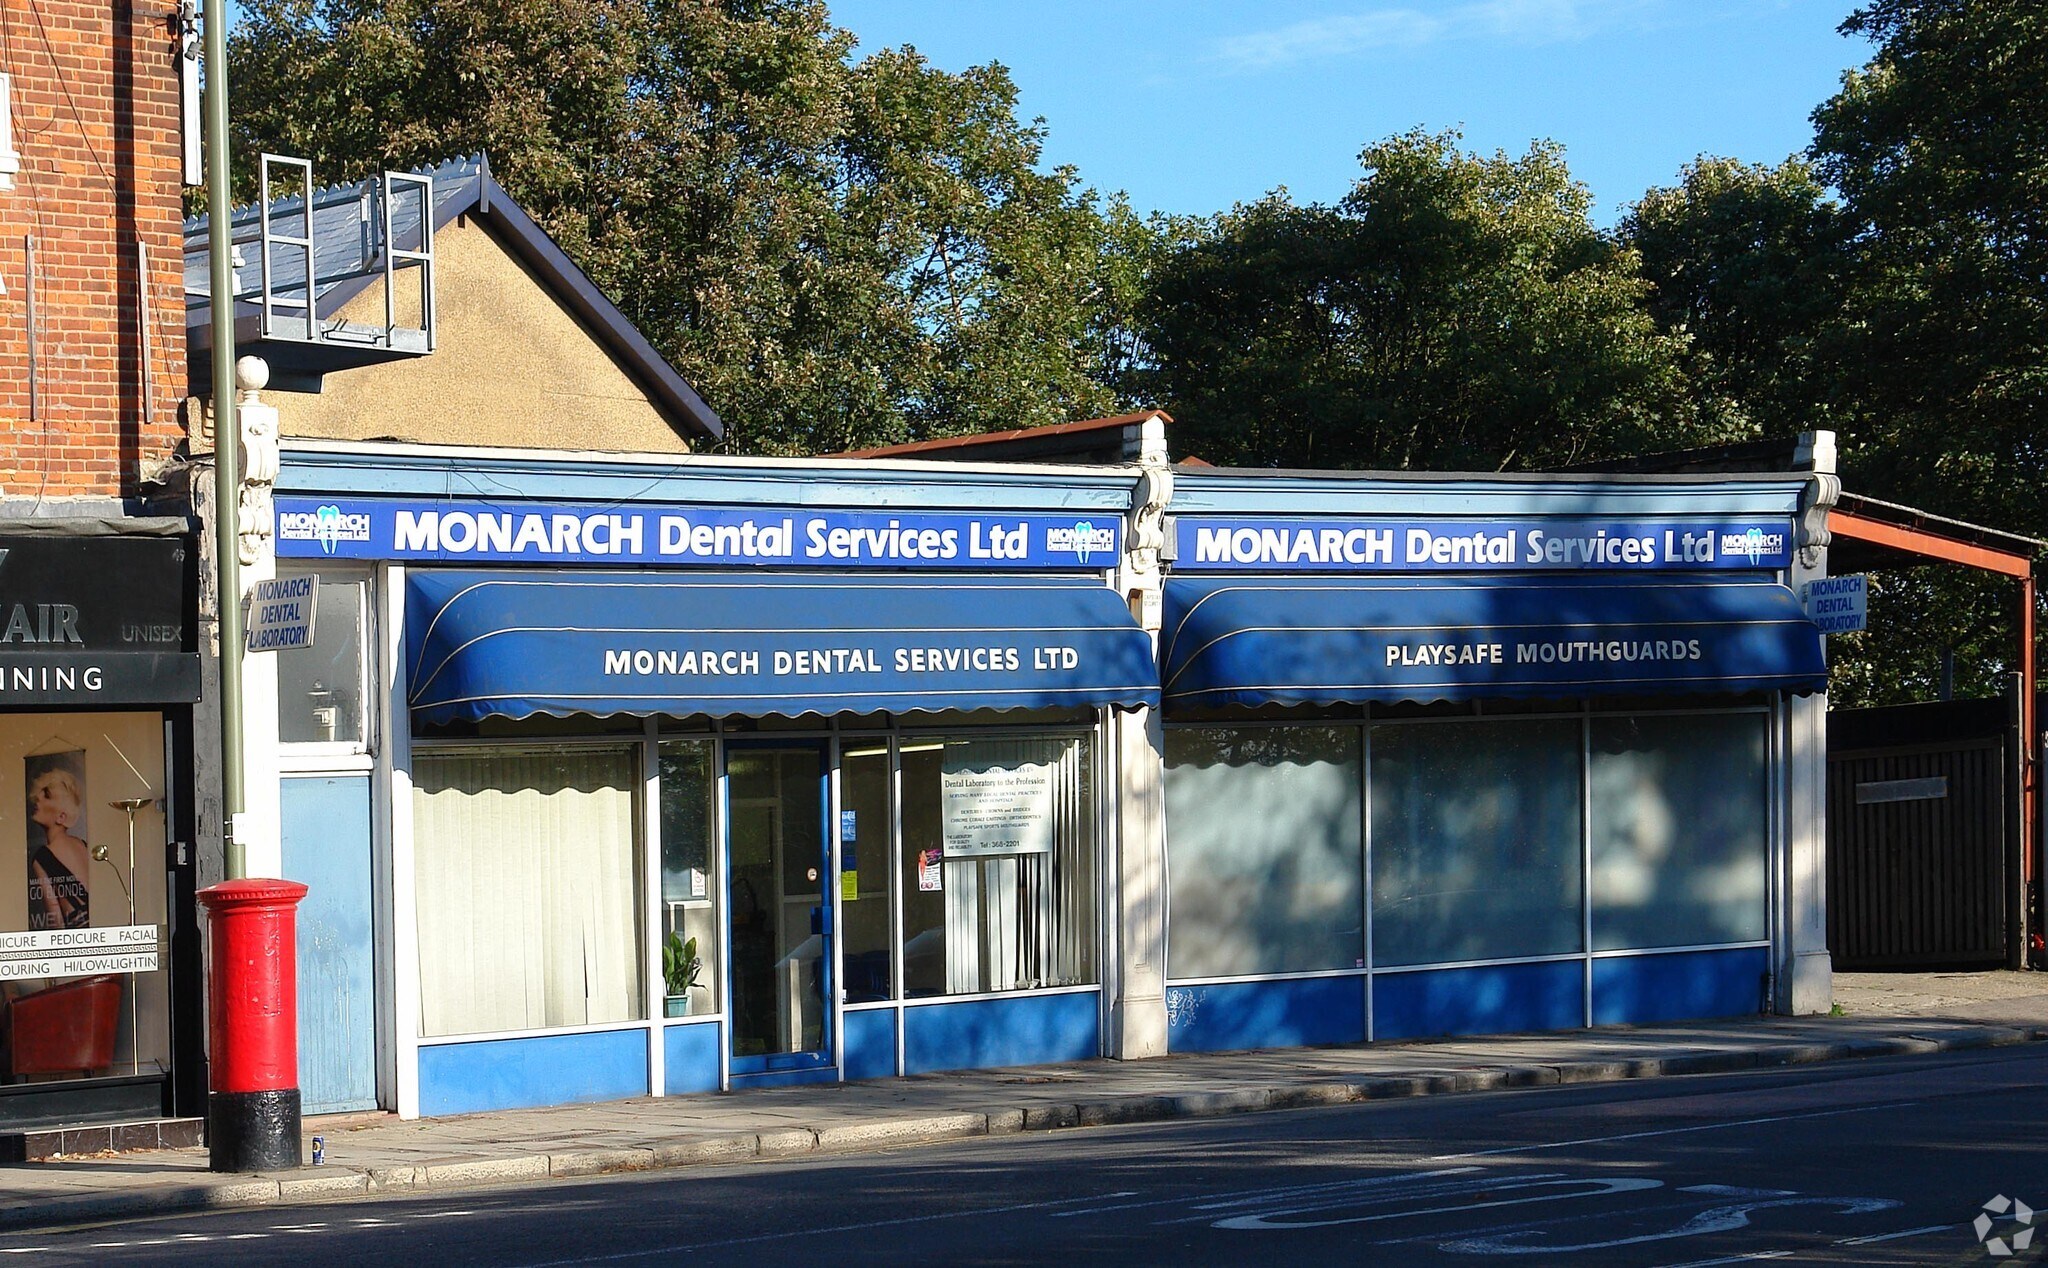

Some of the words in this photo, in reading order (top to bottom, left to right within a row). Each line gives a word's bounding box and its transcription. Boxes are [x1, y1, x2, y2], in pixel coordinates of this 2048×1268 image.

[279, 512, 371, 528] MONARCH
[394, 510, 644, 555] MONARCH
[659, 515, 793, 558] Dental
[805, 518, 958, 559] Services
[969, 521, 1029, 559] Ltd
[1046, 528, 1115, 541] MONARCH
[1721, 534, 1783, 546] MONARCH
[1196, 528, 1394, 564] MONARCH
[1405, 529, 1516, 564] Dental
[1526, 530, 1655, 563] Services
[1664, 530, 1715, 563] Ltd
[257, 577, 312, 602] MONARCH
[1811, 576, 1861, 597] MONARCH
[260, 602, 301, 625] DENTAL
[1816, 598, 1854, 614] DENTAL
[0, 603, 83, 643] AIR
[1814, 613, 1862, 631] ABORATORY
[122, 625, 183, 642] UNISEX
[249, 625, 308, 649] LABORATORY
[604, 649, 760, 676] MONARCH
[773, 648, 883, 676] DENTAL
[894, 647, 1020, 673] SERVICES
[1033, 647, 1080, 671] LTD
[1386, 643, 1503, 668] PLAYSAFE
[1516, 638, 1702, 664] MOUTHGUARDS
[945, 779, 964, 788] Dental
[965, 778, 996, 789] Laboratory
[1005, 778, 1015, 786] the
[1016, 777, 1046, 785] Profession
[30, 886, 43, 900] GO
[0, 935, 37, 949] ICURE
[50, 931, 106, 945] PEDICURE
[64, 955, 158, 973] HI/LOW-LIGHTIN
